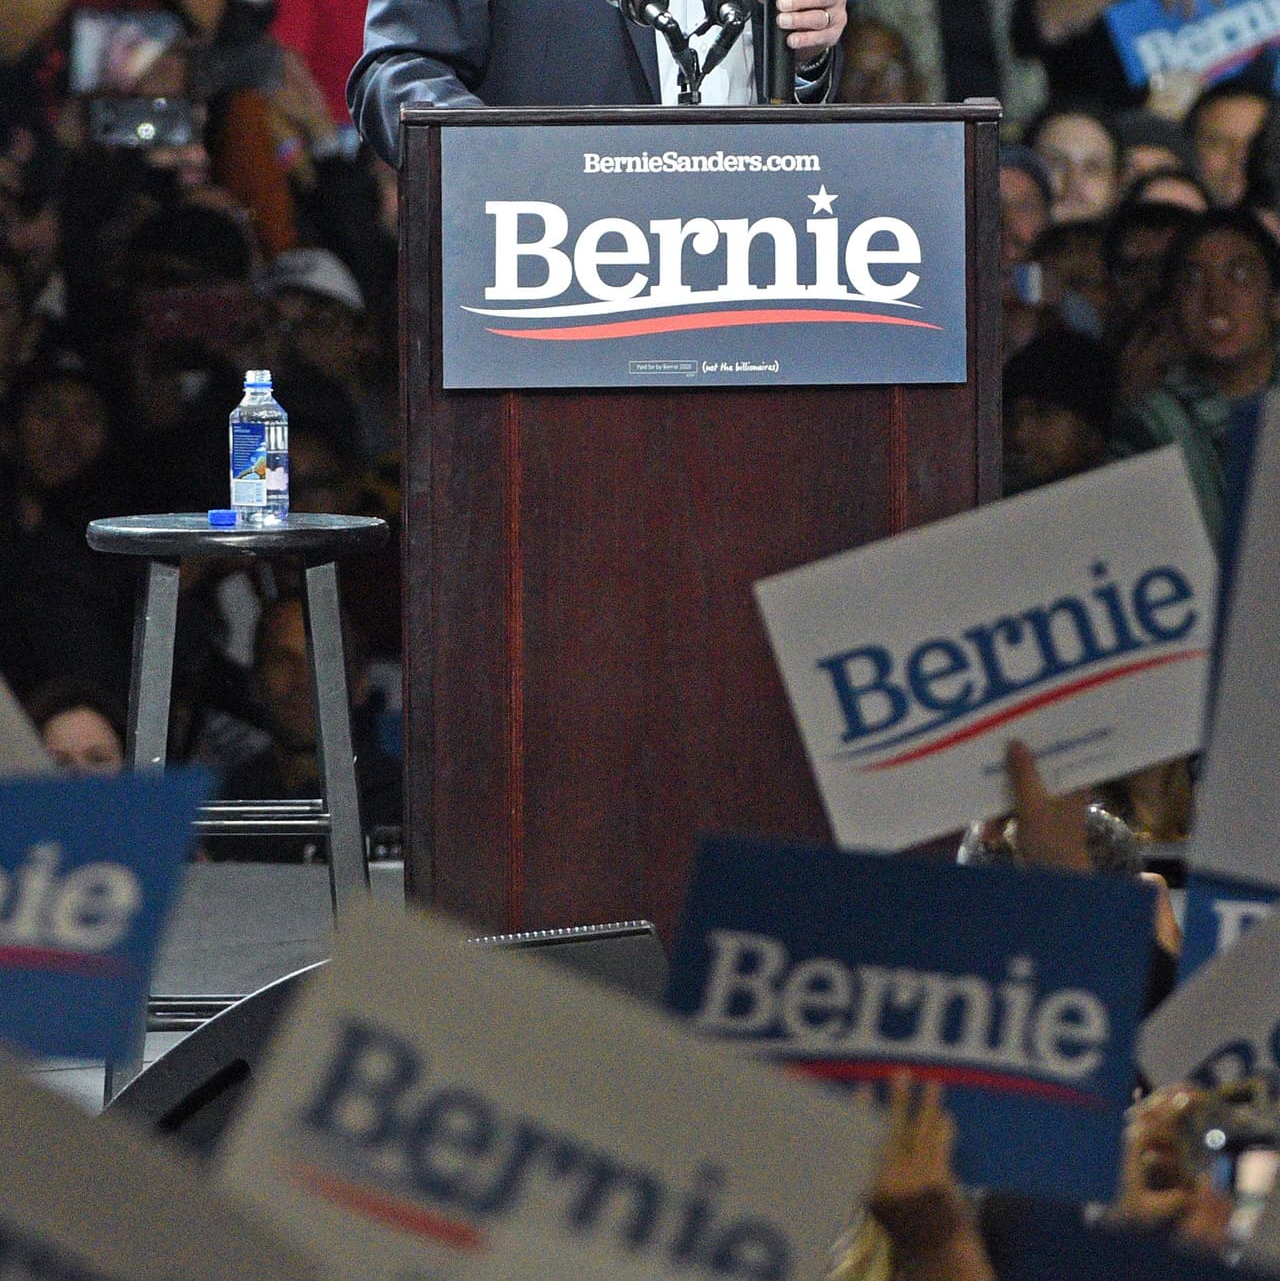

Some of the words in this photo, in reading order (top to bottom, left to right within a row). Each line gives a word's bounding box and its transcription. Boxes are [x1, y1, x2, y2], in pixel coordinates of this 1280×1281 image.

[583, 151, 821, 174] BernieSanders.com
[484, 185, 923, 302] Bernie
[817, 558, 1200, 745] Bernie
[692, 926, 1113, 1082] Bernie
[295, 1013, 790, 1281] Bernie
